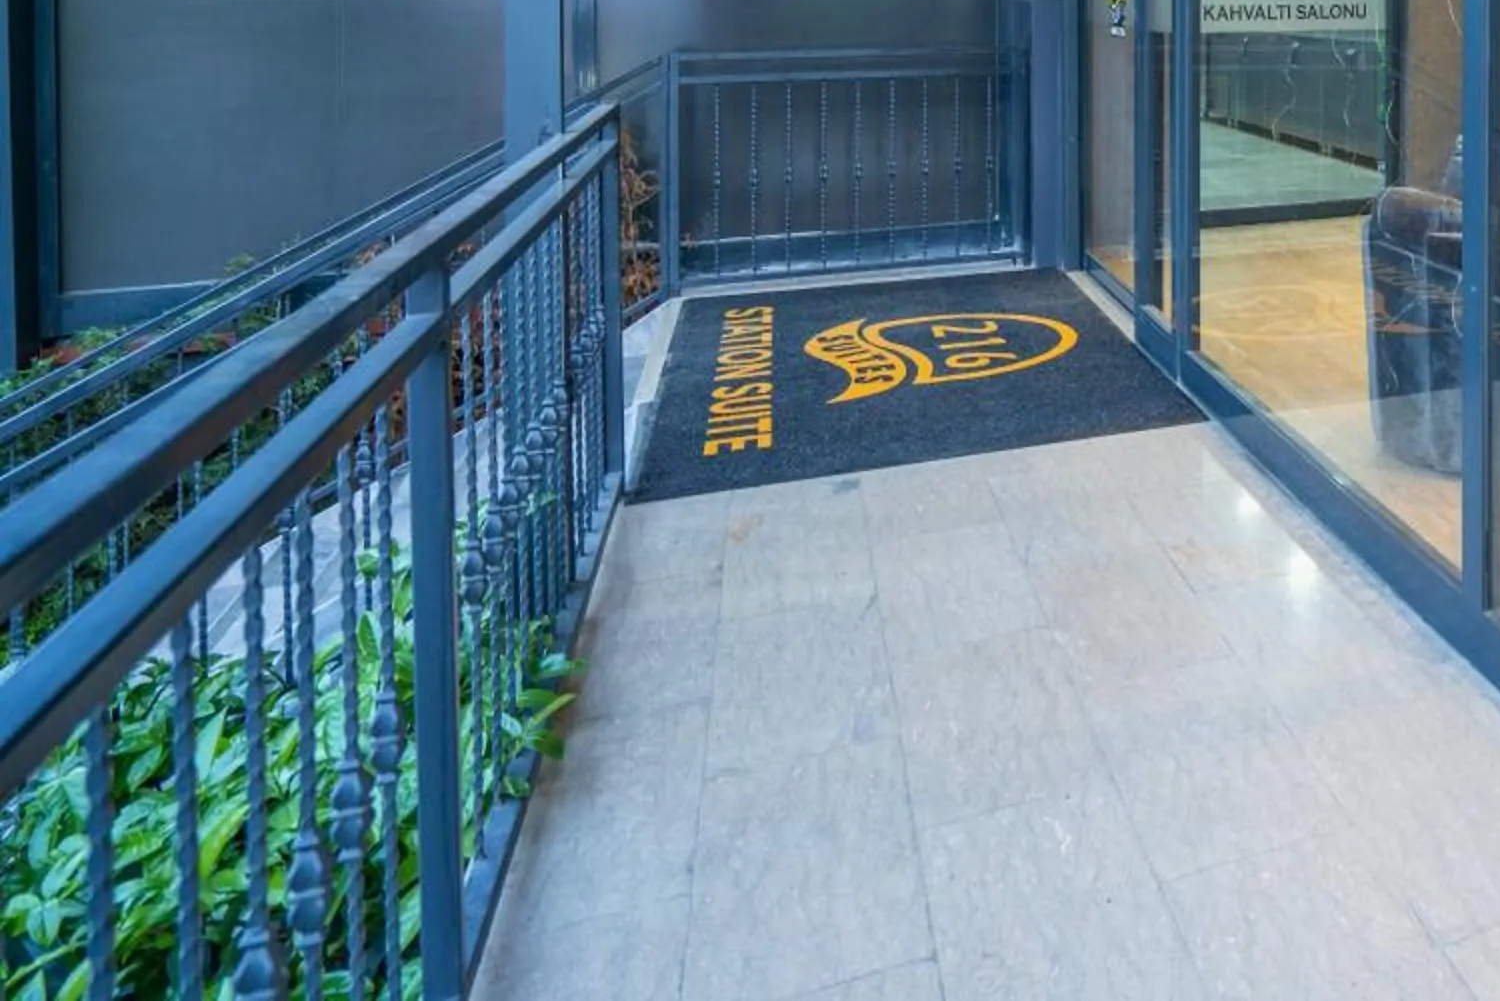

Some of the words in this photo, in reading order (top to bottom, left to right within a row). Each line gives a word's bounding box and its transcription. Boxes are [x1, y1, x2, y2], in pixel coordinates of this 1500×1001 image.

[1202, 4, 1292, 22] KAHVALTI
[1296, 3, 1368, 20] SALONU
[713, 306, 775, 382] STATION
[815, 333, 897, 385] SUITES
[930, 319, 1018, 369] 216
[702, 382, 773, 456] SUITE
